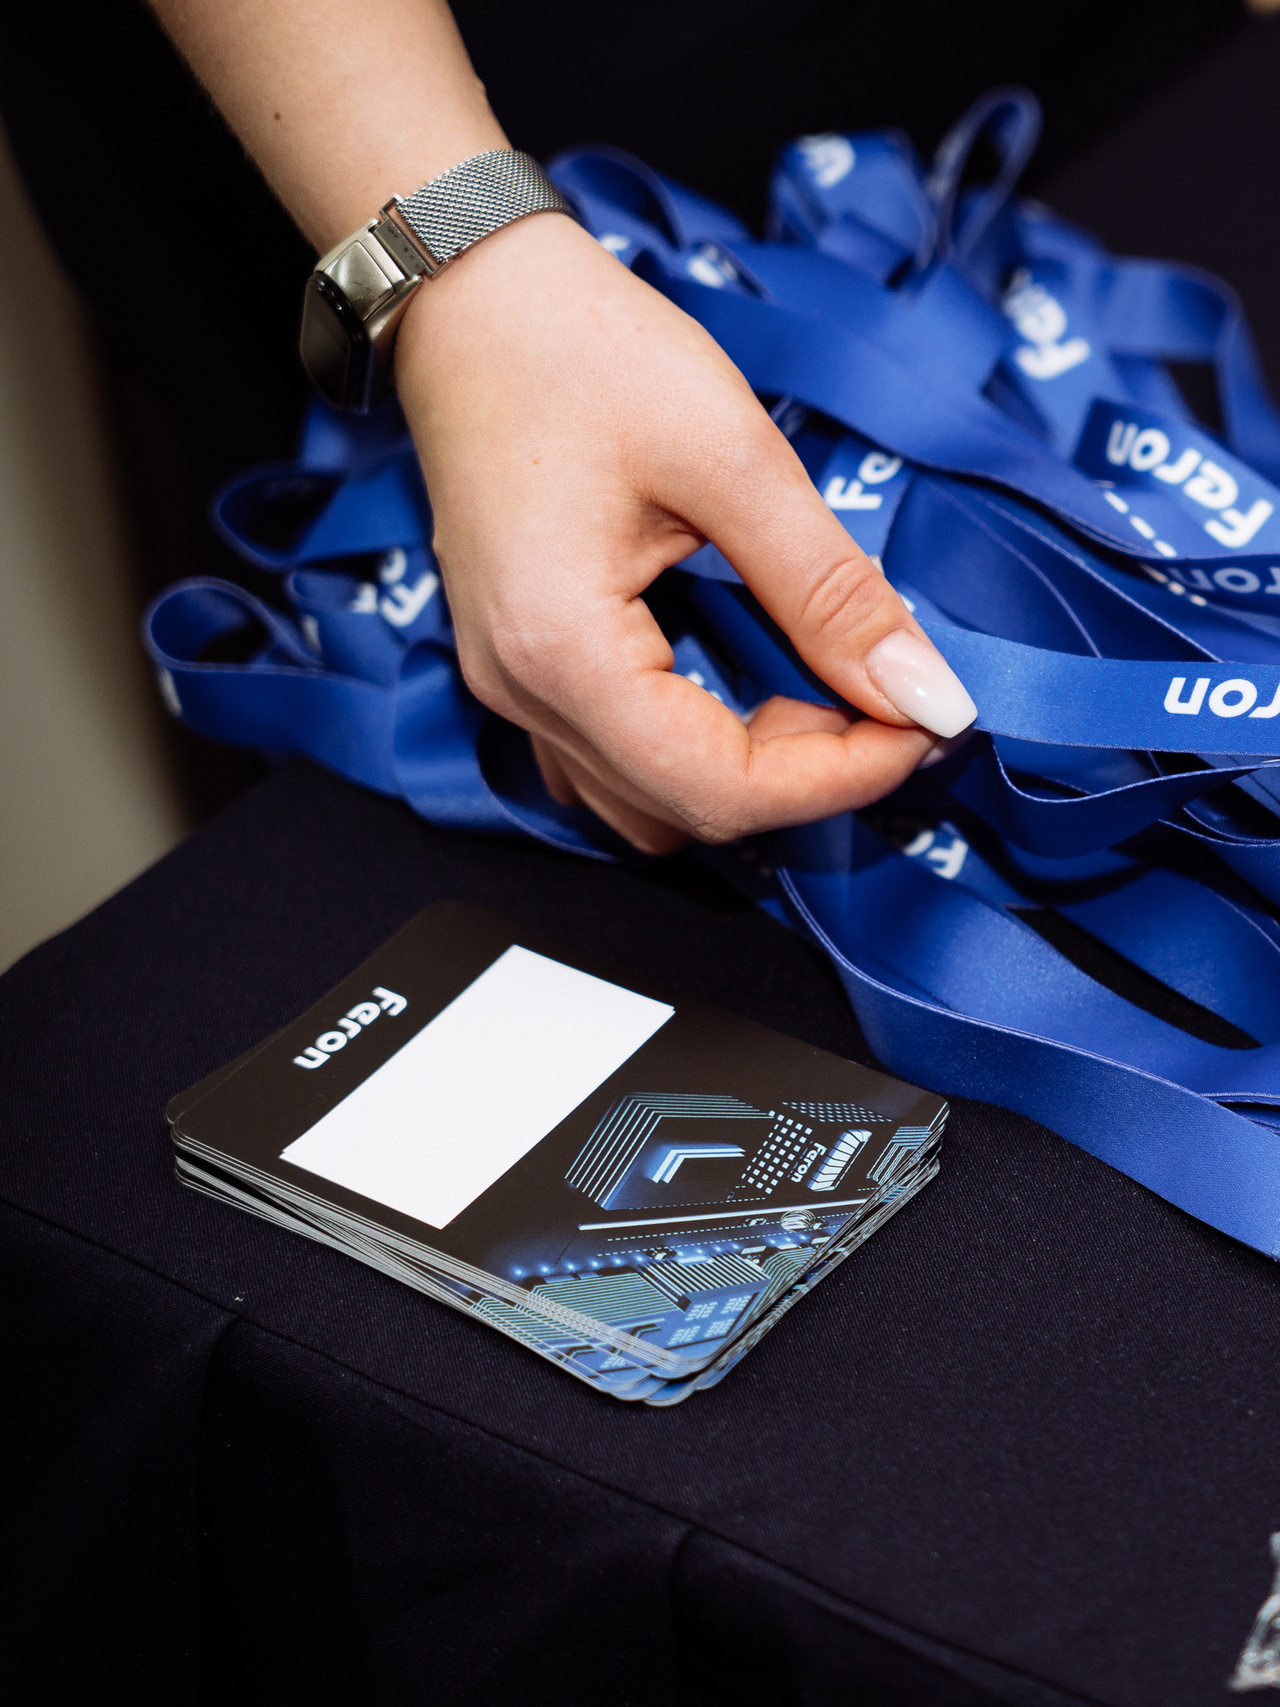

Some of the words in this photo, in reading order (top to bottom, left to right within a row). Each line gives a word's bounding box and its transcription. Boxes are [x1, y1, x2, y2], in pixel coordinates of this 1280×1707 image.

[1106, 420, 1274, 548] Feron
[292, 986, 408, 1070] Feron
[790, 1142, 828, 1183] Feron
